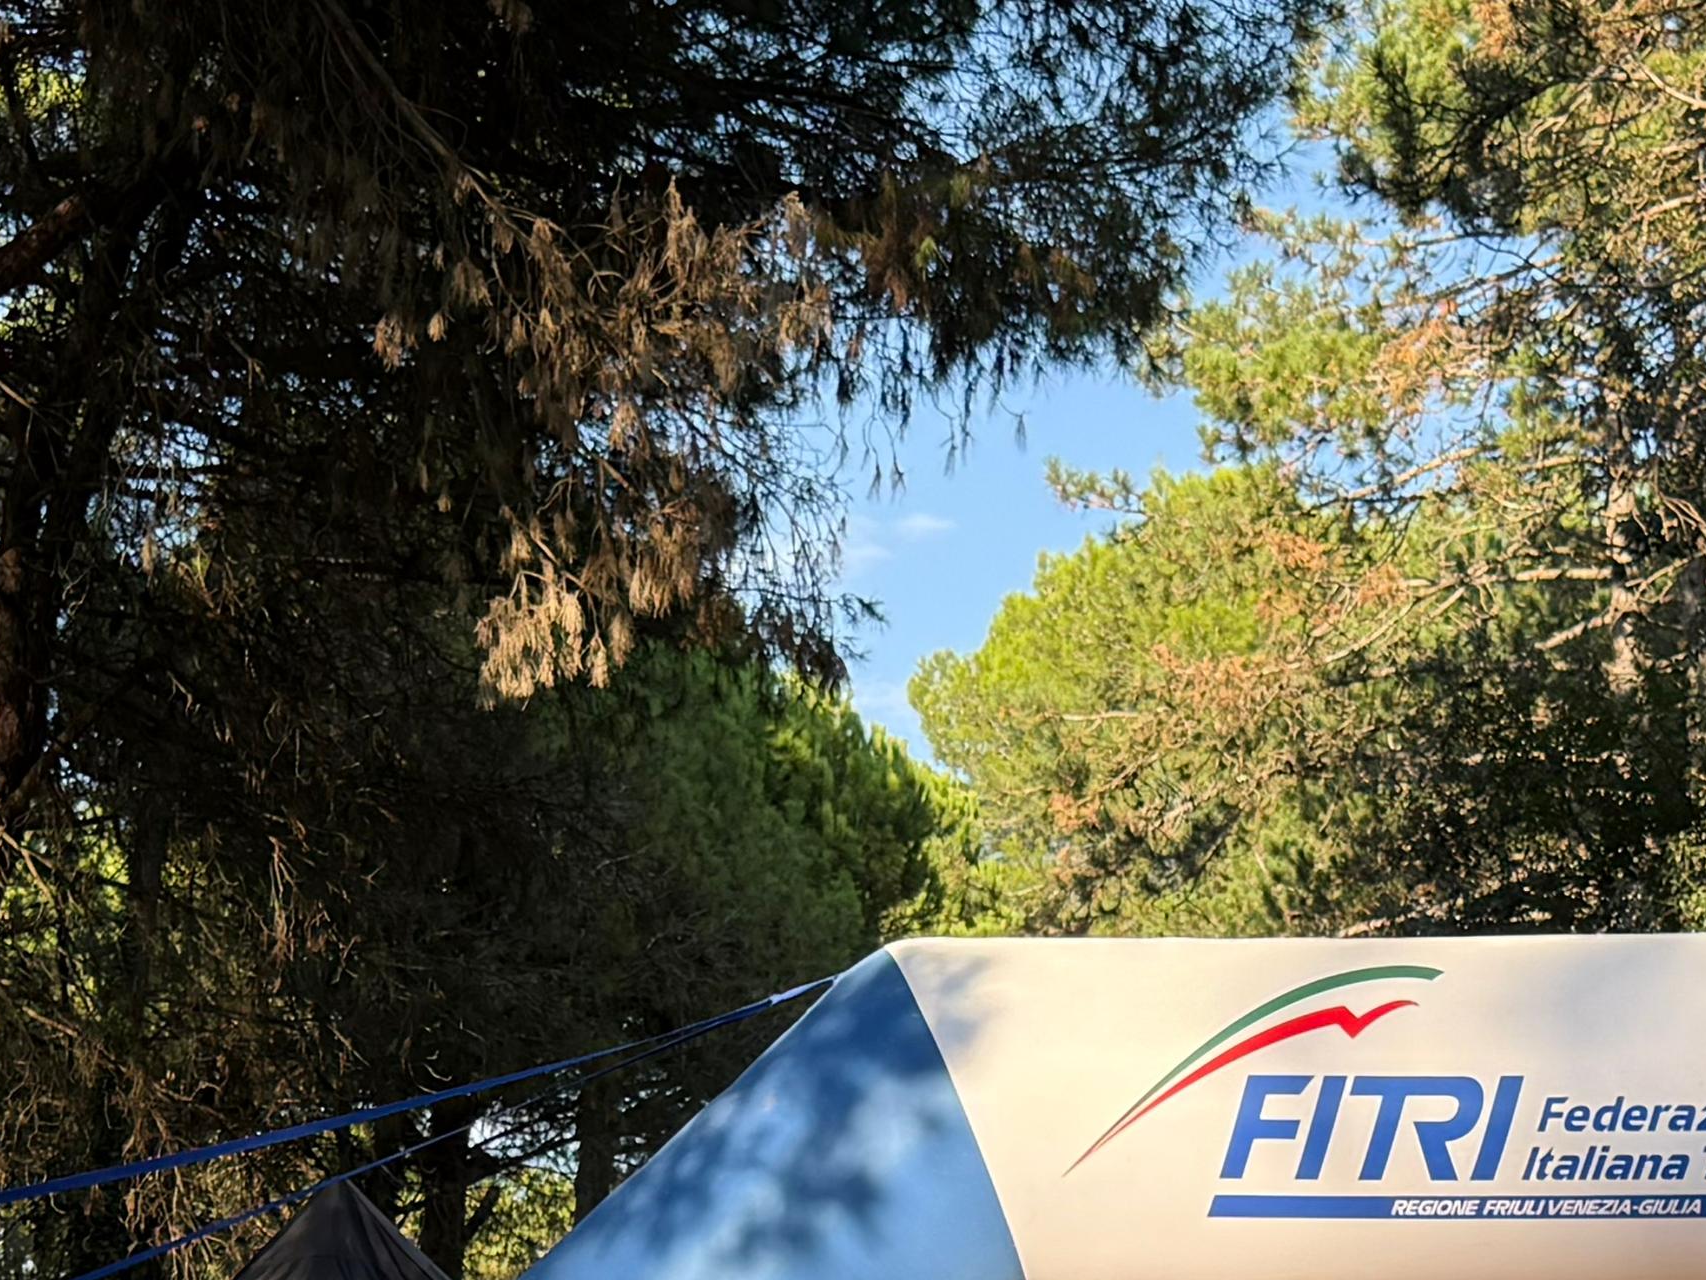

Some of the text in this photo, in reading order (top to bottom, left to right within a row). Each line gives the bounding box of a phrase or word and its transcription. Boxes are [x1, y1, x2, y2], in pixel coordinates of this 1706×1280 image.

[1219, 1075, 1524, 1181] FITRI
[1521, 1145, 1686, 1182] Italiana
[1391, 1197, 1702, 1217] REGIONE FRIULI VENEZIA-GIULIA
